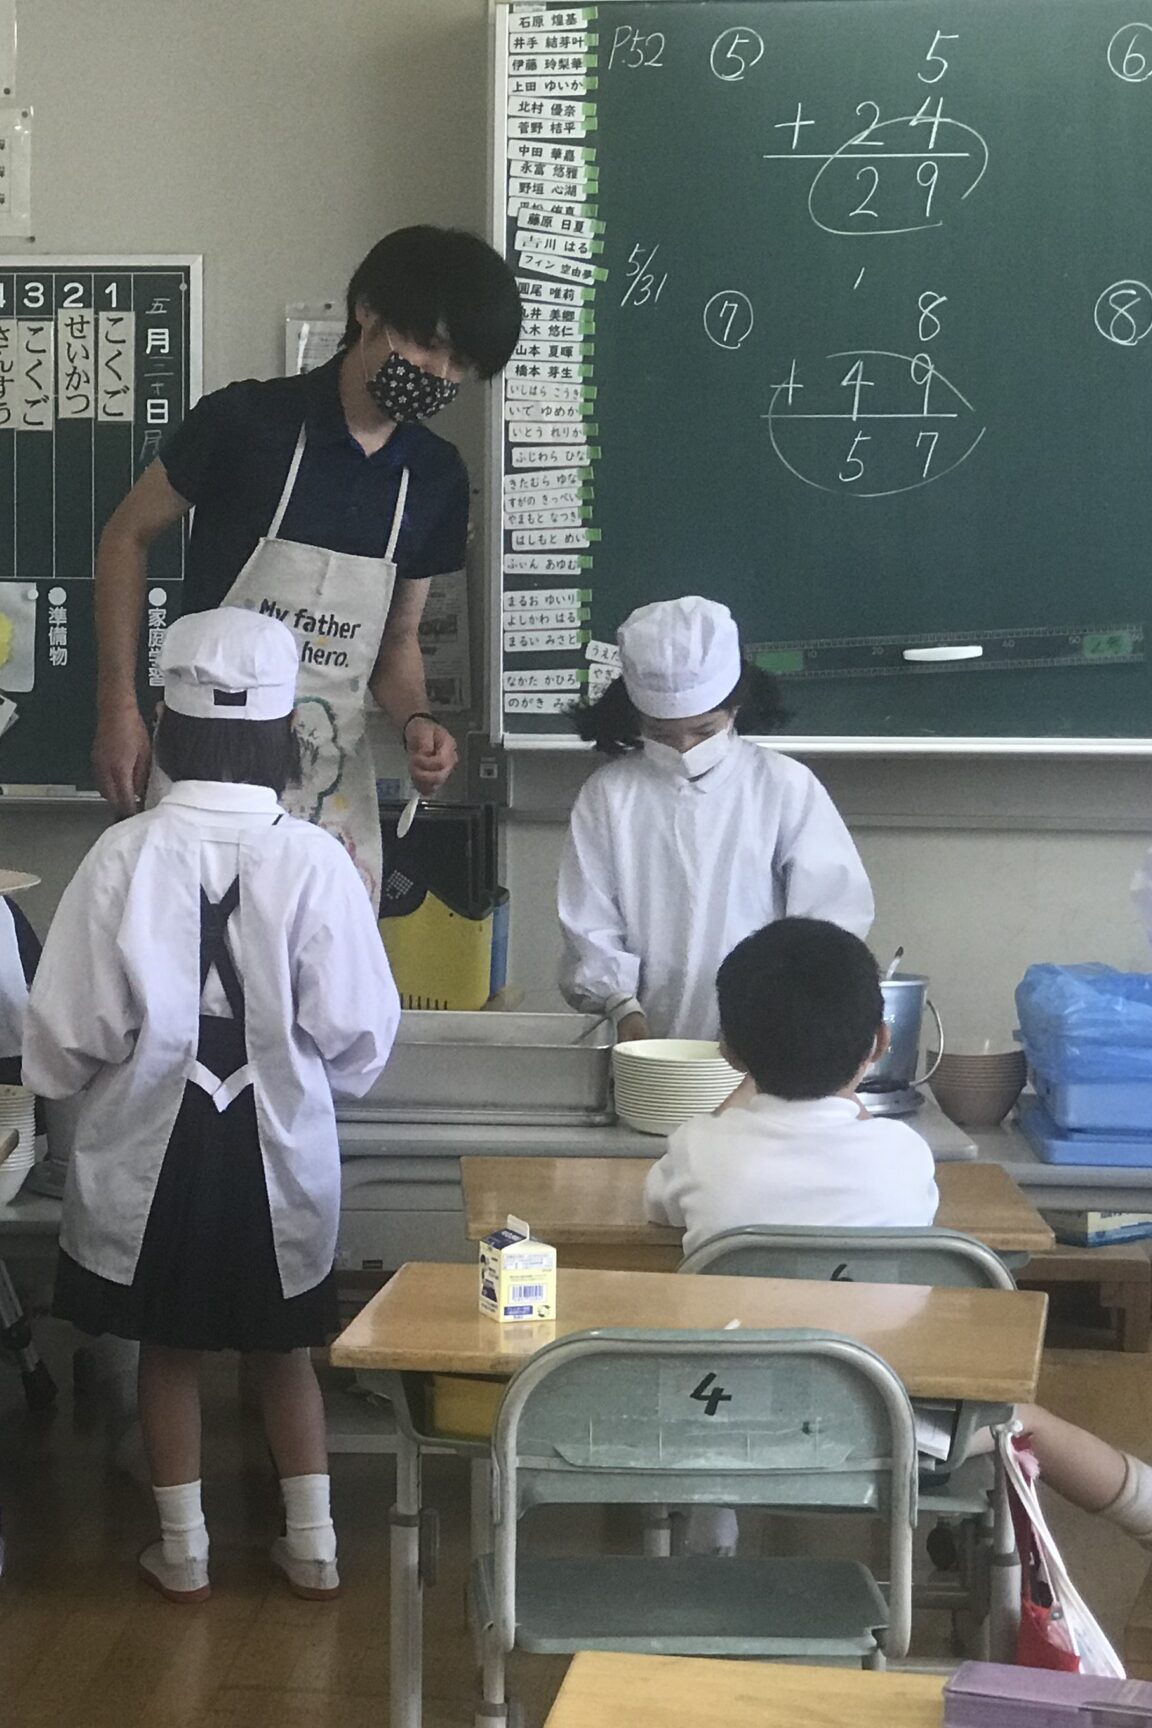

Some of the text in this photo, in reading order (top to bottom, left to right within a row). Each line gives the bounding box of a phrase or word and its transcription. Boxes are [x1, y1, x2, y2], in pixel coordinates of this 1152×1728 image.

[519, 15, 544, 28] 石原
[514, 36, 538, 49] 井手
[917, 30, 959, 83] 5
[512, 80, 583, 92] 上田 ゆいか
[518, 101, 544, 114] 北村
[519, 144, 543, 157] 中田
[564, 241, 588, 254] はる
[23, 283, 45, 307] 3
[63, 283, 85, 307] 2
[104, 283, 118, 307] 1
[917, 291, 947, 341] 8
[515, 344, 541, 357] 山本
[64, 314, 91, 414] せいかつ
[102, 317, 130, 418] こくご
[515, 364, 541, 377] 橋本
[23, 326, 48, 427] こくご
[293, 608, 362, 640] father
[555, 612, 576, 623] はる
[301, 641, 349, 668] hero.
[689, 1372, 733, 1416] 4
